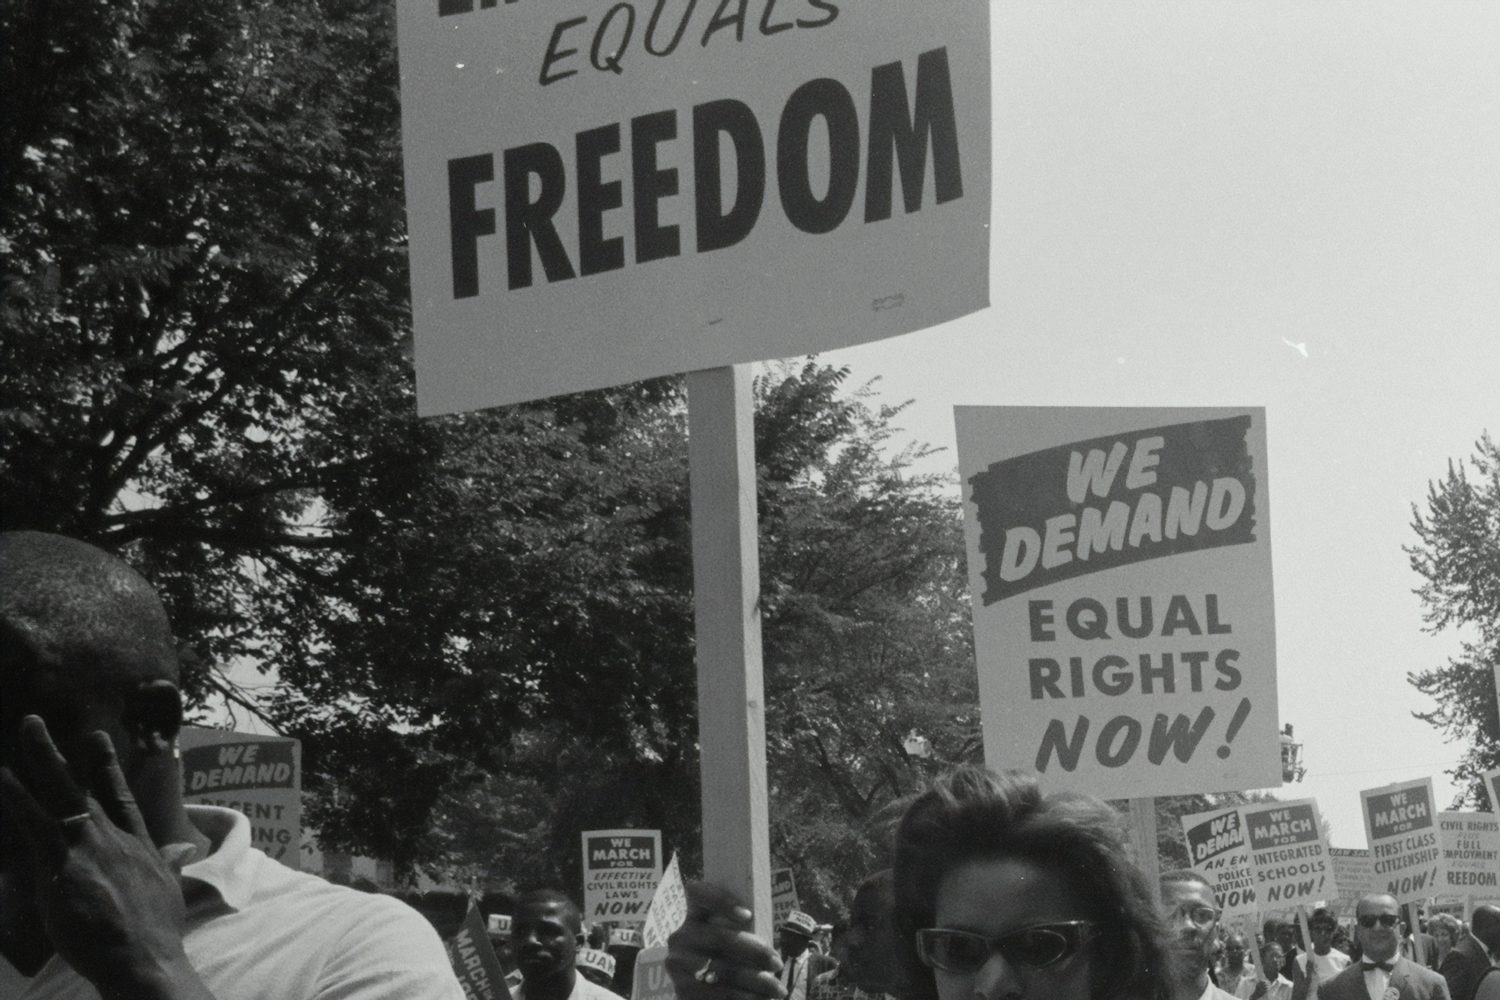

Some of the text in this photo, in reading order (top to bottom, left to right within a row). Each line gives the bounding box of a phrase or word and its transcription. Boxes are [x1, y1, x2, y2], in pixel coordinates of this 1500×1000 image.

[447, 46, 964, 300] FREEDOM
[1066, 436, 1165, 503] WE
[999, 477, 1246, 582] DEMAND
[1028, 593, 1232, 642] EQUAL
[1028, 648, 1242, 700] RIGHTS
[1035, 697, 1252, 773] NOW!
[218, 744, 259, 766] WE
[190, 762, 290, 791] DEMAND
[1390, 793, 1407, 806] WE
[1210, 813, 1237, 836] WE
[1270, 810, 1291, 822] WE
[1375, 802, 1426, 827] MARCH
[1254, 819, 1312, 839] MARCH
[1393, 822, 1413, 833] FOR
[1441, 821, 1463, 831] CIVIL
[1468, 822, 1499, 832] RIGHTS
[610, 838, 631, 848] WE
[1196, 829, 1243, 860] DEMA
[1273, 835, 1297, 845] FOR
[1374, 841, 1404, 858] FIRST
[1406, 833, 1436, 851] CLASS
[1457, 840, 1481, 849] FULL
[593, 848, 651, 861] MARCH
[1204, 858, 1225, 871] AN
[1230, 855, 1248, 866] EN
[1254, 845, 1322, 866] INTEGRATED
[1374, 848, 1439, 874] CITIZENSHIP
[594, 872, 653, 881] EFFECTIVE
[1218, 868, 1251, 882] POLICE
[1258, 861, 1326, 882] SCHOOLS
[1387, 866, 1437, 896] NOW!
[1447, 871, 1497, 886] REEDOM
[587, 881, 658, 891] CIVIL RIGHTS
[605, 891, 639, 899] LAWS
[1267, 875, 1325, 902] NOW!
[594, 900, 653, 916] NOW!
[457, 929, 491, 992] MARCH
